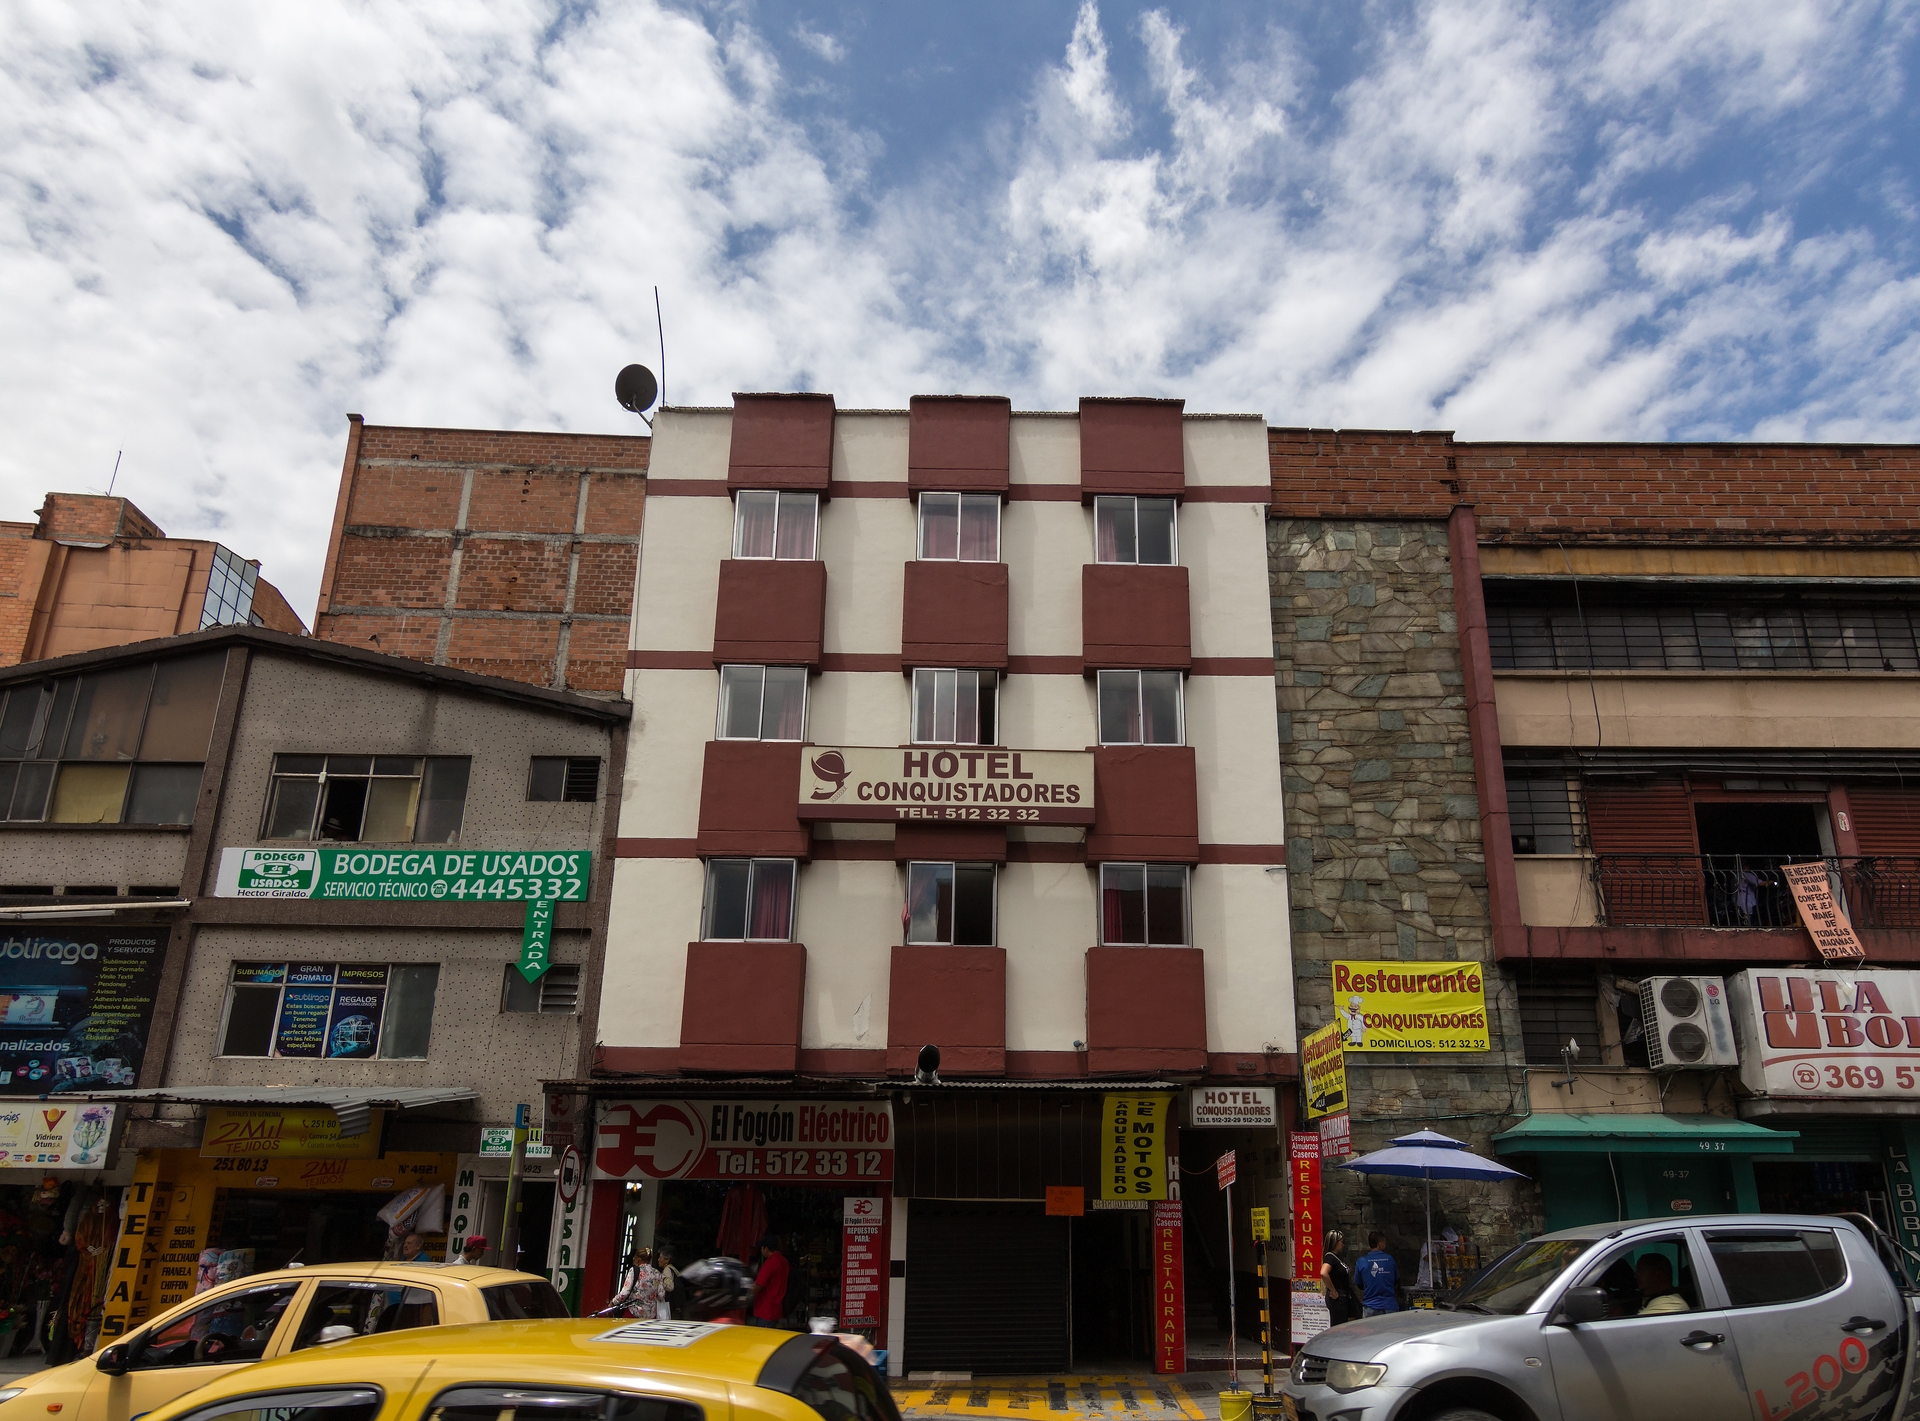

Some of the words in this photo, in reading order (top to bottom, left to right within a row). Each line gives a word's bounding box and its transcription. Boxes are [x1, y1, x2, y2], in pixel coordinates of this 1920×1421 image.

[903, 751, 1034, 780] HOTEL
[856, 781, 1081, 803] CONQUISTADORES
[896, 807, 939, 819] TEL:
[945, 808, 980, 820] 512
[987, 809, 1010, 820] 32
[1016, 809, 1040, 820] 32
[254, 853, 306, 861] BODEGA
[333, 854, 437, 875] BODEGA
[443, 854, 477, 875] DE
[481, 854, 580, 876] USADOS
[250, 879, 300, 889] USADOS
[323, 882, 376, 898] SERVICIO
[378, 878, 428, 898] TÉCNICO
[450, 878, 582, 900] 4445332
[1803, 884, 1822, 893] PARA
[1807, 902, 1818, 911] DE
[1825, 919, 1836, 928] DE
[524, 900, 549, 970] ENTRADA
[291, 974, 332, 982] FORMATO
[341, 970, 385, 978] IMPRESOS
[1334, 964, 1481, 994] Restaurante
[1815, 980, 1892, 1014] LA
[1362, 1013, 1485, 1032] CONQUISTADORES
[0, 1040, 70, 1052] nalizados
[1302, 1028, 1341, 1064] Restaurante
[1370, 1039, 1436, 1048] DOMICILIOS:
[1438, 1040, 1456, 1048] 512
[1459, 1040, 1470, 1048] 32
[1473, 1040, 1486, 1048] 32
[1824, 1065, 1884, 1089] 369
[1204, 1092, 1262, 1104] HOTEL
[1136, 1102, 1156, 1116] DE
[1196, 1106, 1271, 1116] CONQUISTADORES
[310, 1120, 326, 1128] 251
[326, 1120, 336, 1128] 80
[710, 1104, 730, 1142] El
[732, 1104, 794, 1146] Fogón
[798, 1104, 889, 1144] Eléctrico
[1320, 1114, 1350, 1141] RESTAURANTE
[208, 1117, 286, 1146] 2Mil
[1291, 1134, 1318, 1142] Desayunos
[226, 1140, 280, 1154] TEJIDOS
[1698, 1142, 1710, 1150] 49
[1714, 1142, 1726, 1151] 37
[1132, 1122, 1154, 1194] MOTOS
[1292, 1150, 1319, 1159] Caseros
[1888, 1145, 1910, 1174] LA
[213, 1158, 234, 1171] 251
[236, 1158, 252, 1171] 80
[252, 1159, 268, 1172] 13
[716, 1150, 761, 1175] Tel:
[766, 1150, 810, 1176] 512
[814, 1151, 848, 1176] 33
[853, 1151, 882, 1176] 12
[410, 1165, 438, 1174] 4921
[1662, 1170, 1690, 1178] 49-37
[306, 1175, 344, 1188] TEJIDOS
[1155, 1201, 1182, 1210] Desayunos
[1155, 1210, 1182, 1218] Almuerzos
[1156, 1218, 1182, 1227] Caseros
[174, 1226, 195, 1235] SEDAS
[169, 1240, 195, 1248] GENERO
[102, 1182, 153, 1336] TELAS
[160, 1253, 199, 1262] ACOLCHADO
[162, 1267, 192, 1276] FRANELA
[160, 1280, 189, 1290] CHIFFON
[160, 1294, 183, 1304] GUATA
[1163, 1228, 1176, 1370] RESTAURANTE
[1754, 1336, 1870, 1421] L200
